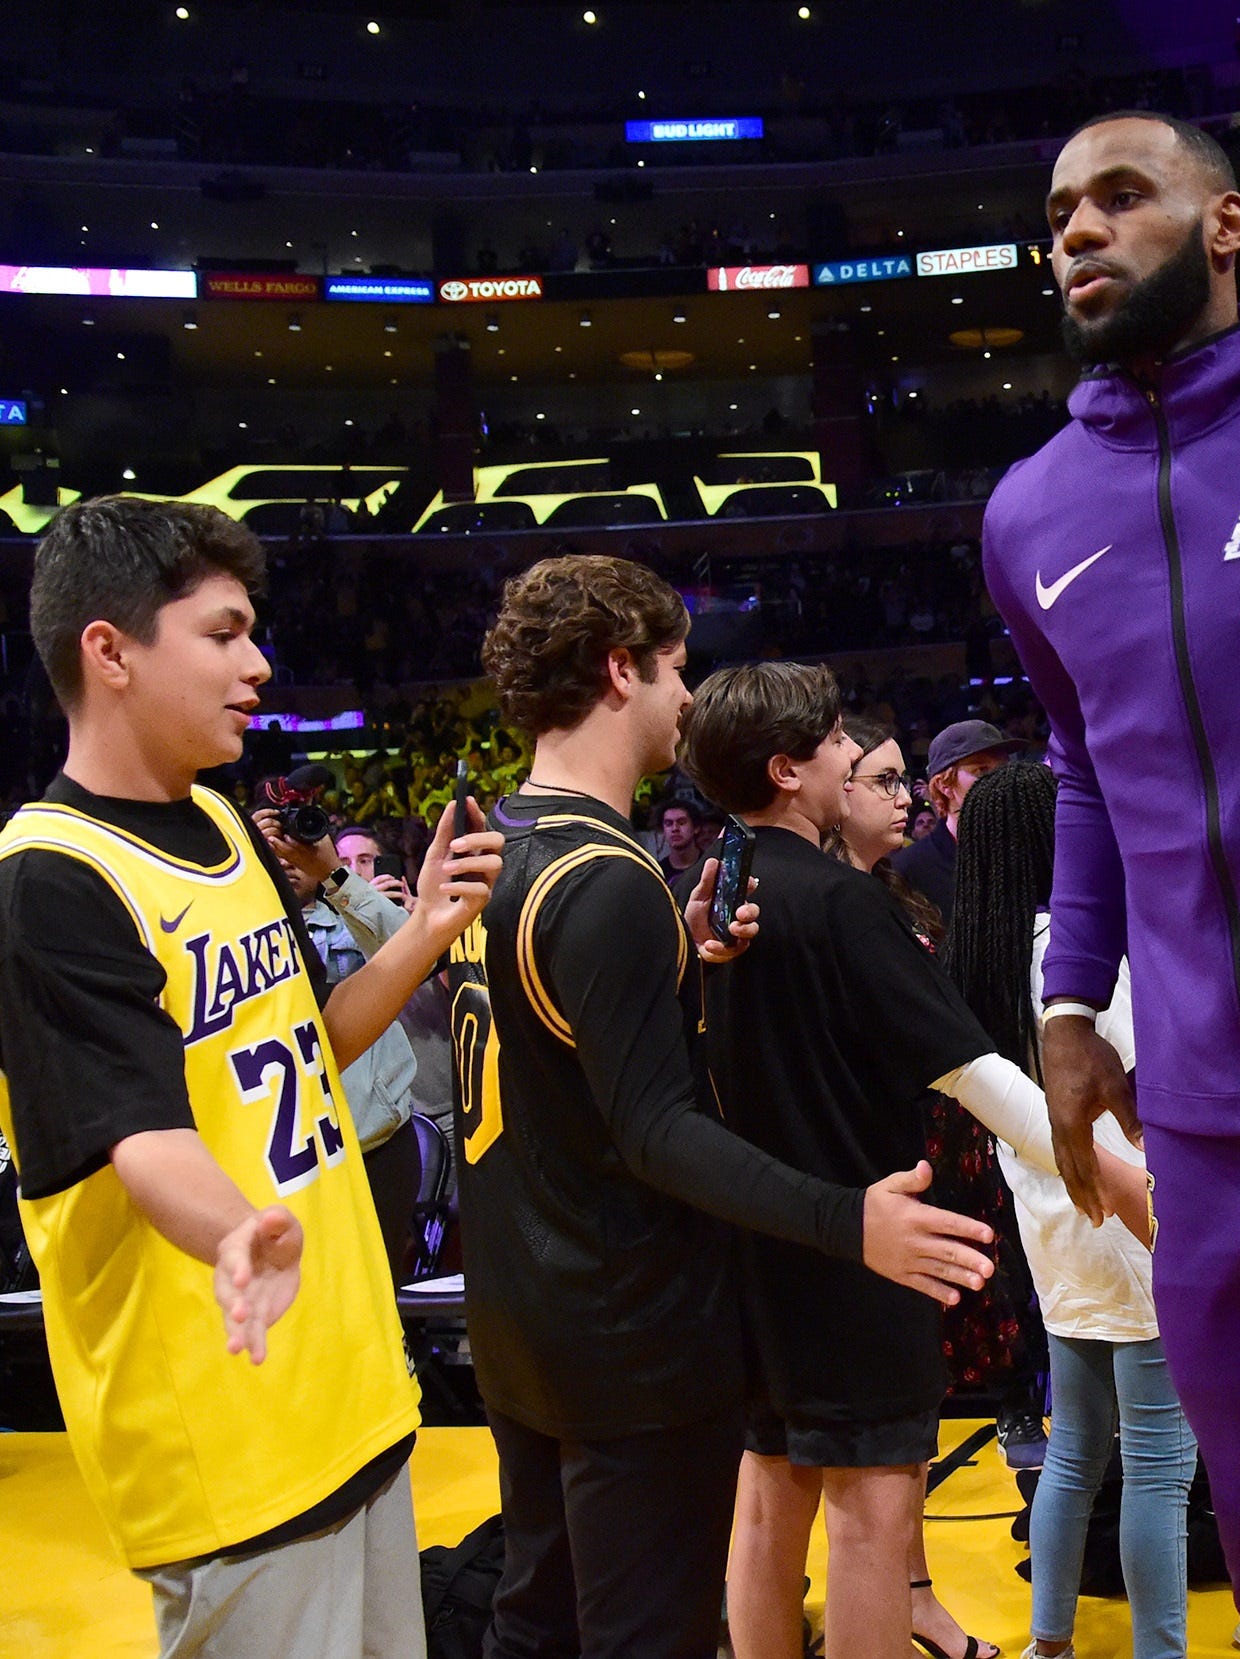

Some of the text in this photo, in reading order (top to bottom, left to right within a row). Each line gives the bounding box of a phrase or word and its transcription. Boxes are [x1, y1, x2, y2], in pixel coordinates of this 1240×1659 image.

[653, 123, 735, 138] BUD LIGHT
[920, 247, 1013, 274] STAPLES
[840, 259, 910, 279] DELTA
[208, 281, 316, 294] WELLS FARGO
[329, 285, 430, 295] AMERICAN EXPRESS
[469, 280, 541, 298] TOYOTA
